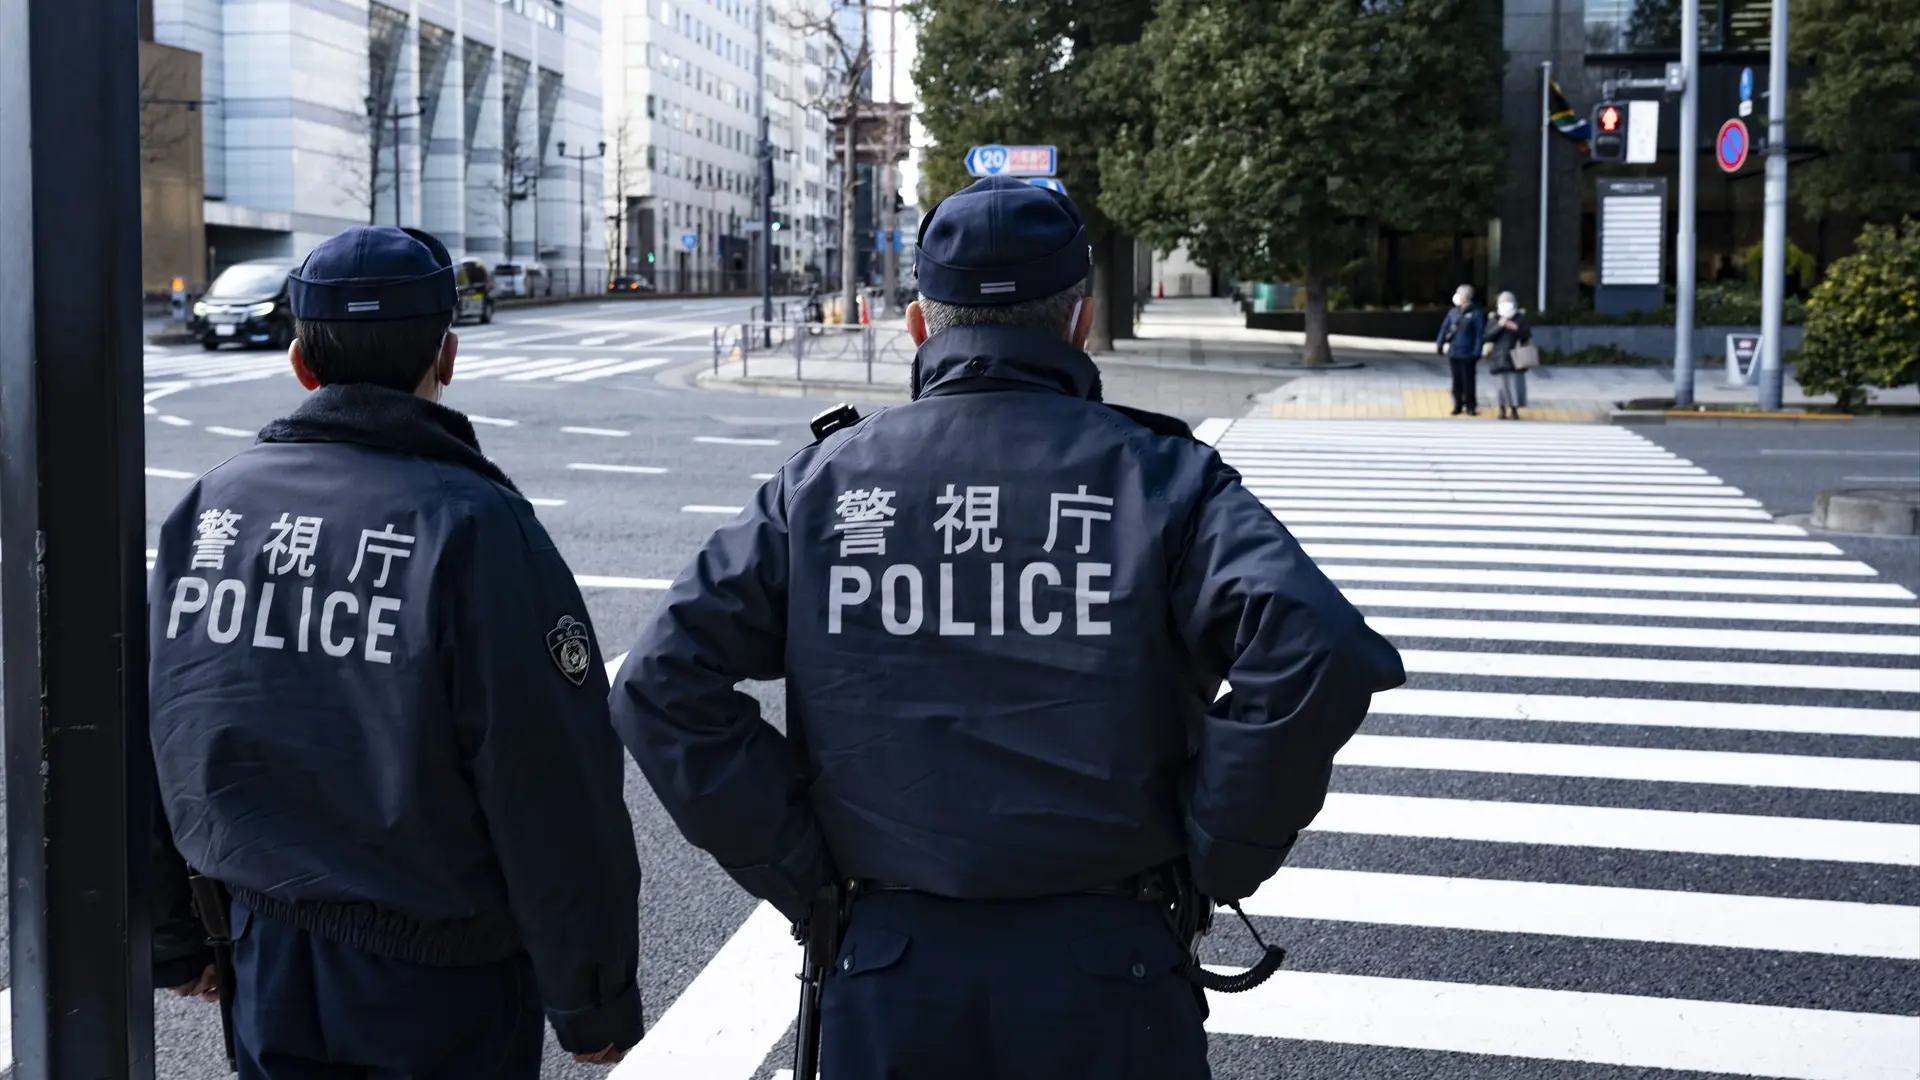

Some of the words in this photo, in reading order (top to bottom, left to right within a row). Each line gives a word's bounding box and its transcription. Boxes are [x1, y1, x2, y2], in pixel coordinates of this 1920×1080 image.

[982, 150, 1004, 168] 20
[190, 508, 416, 588] 警視庁
[833, 484, 1114, 558] 警視庁
[166, 576, 401, 664] POLICE
[828, 561, 1112, 636] POLICE
